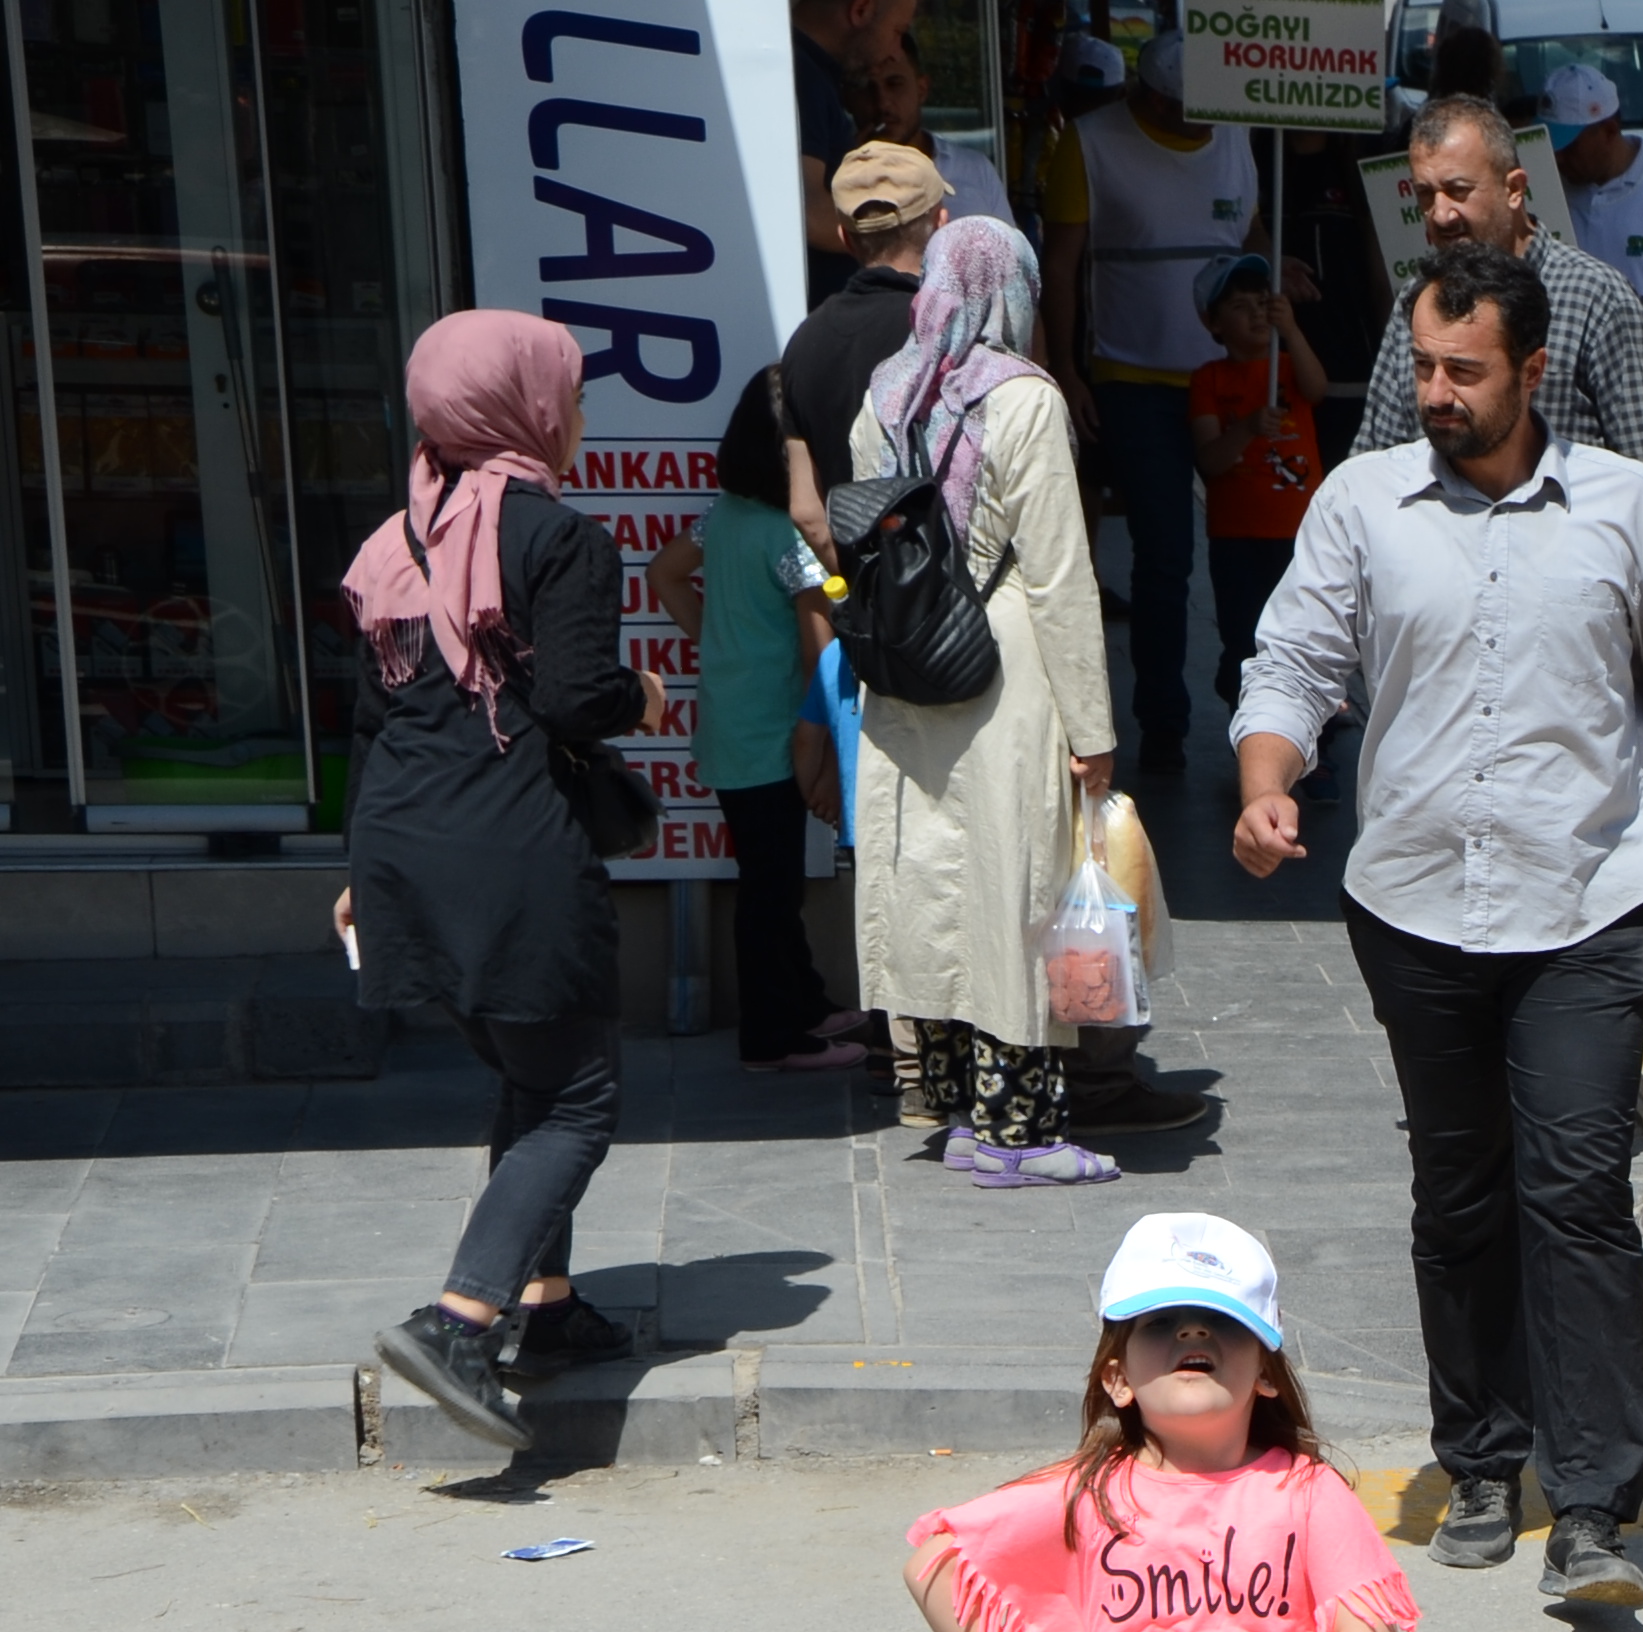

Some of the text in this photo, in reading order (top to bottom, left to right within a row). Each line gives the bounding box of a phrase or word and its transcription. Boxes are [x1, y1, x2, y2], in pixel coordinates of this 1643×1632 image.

[1186, 5, 1311, 42] DOĞAYI
[1223, 41, 1378, 75] KORUMAK
[1244, 72, 1382, 110] ELİMİZDE
[1100, 1525, 1296, 1623] Smile!
